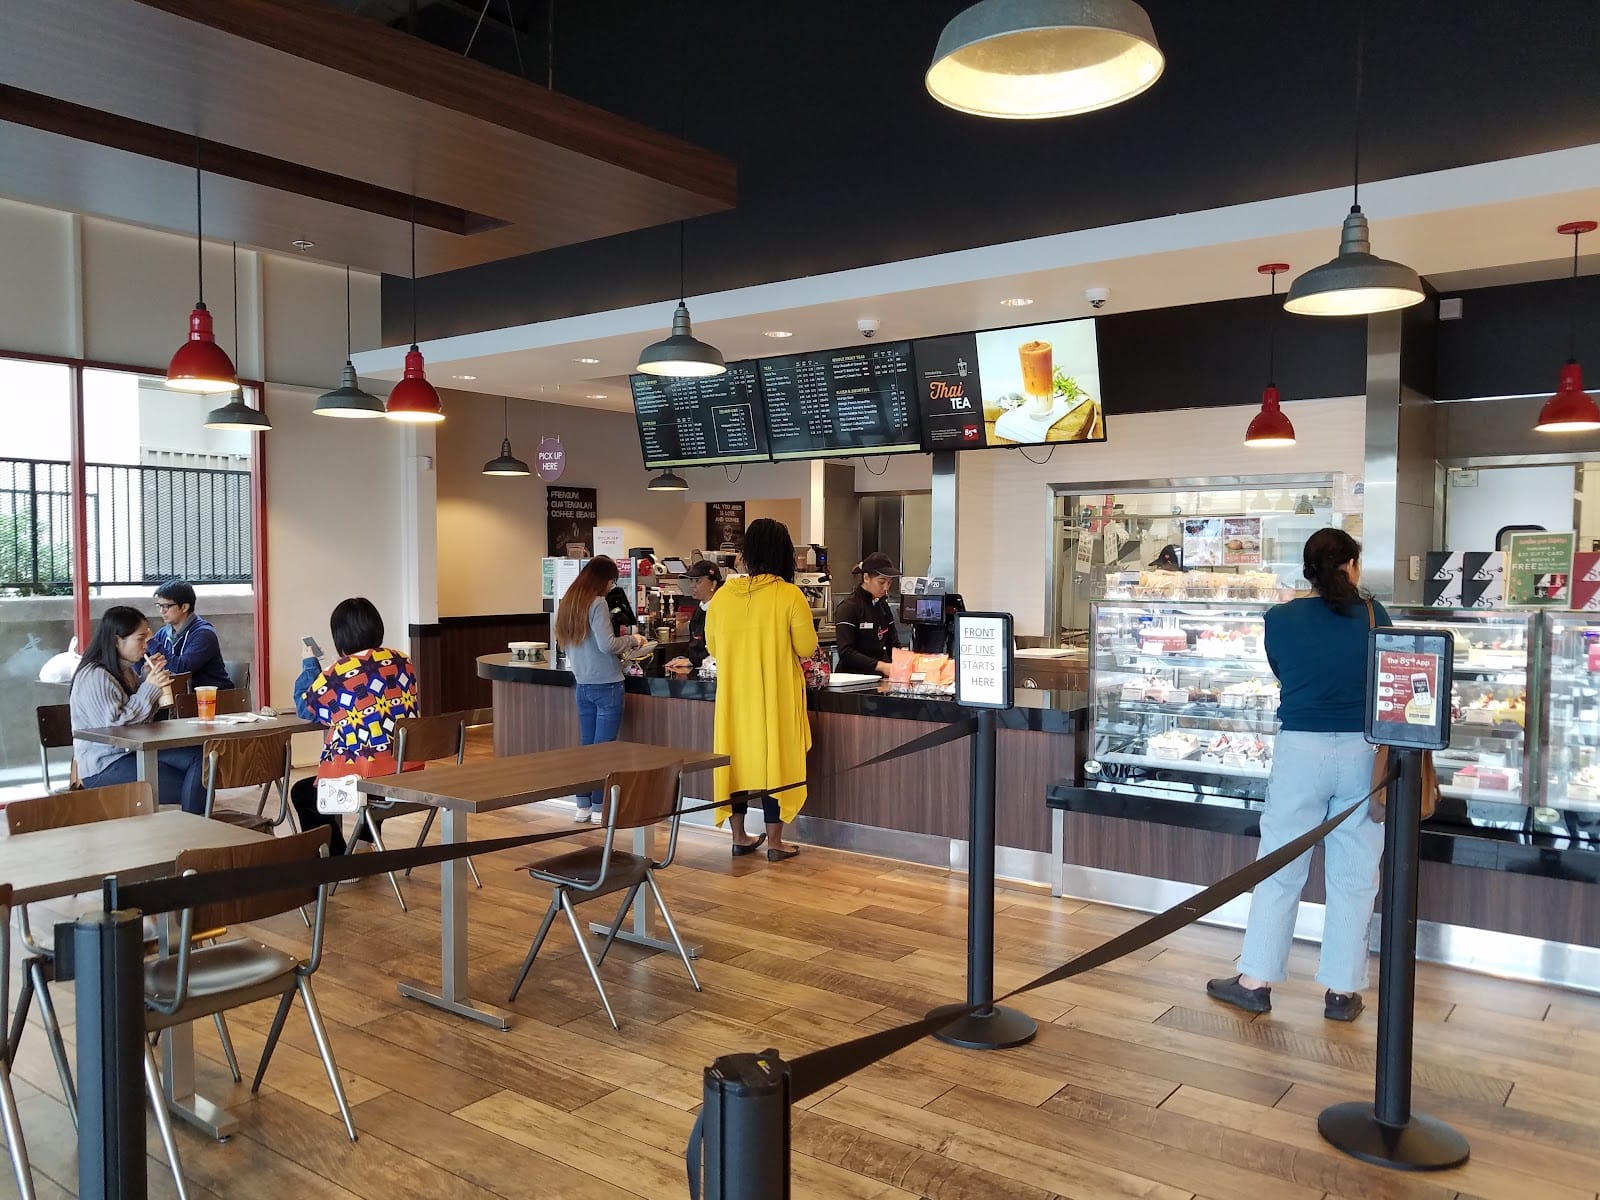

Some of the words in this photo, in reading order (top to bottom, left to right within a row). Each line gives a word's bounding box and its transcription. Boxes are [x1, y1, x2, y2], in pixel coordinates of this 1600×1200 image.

[930, 381, 964, 399] Thai
[950, 397, 971, 410] TEA
[539, 452, 553, 460] PICK
[554, 452, 562, 460] UP
[551, 491, 579, 499] PREMIUM
[551, 510, 575, 518] COFFEE
[964, 627, 995, 637] FRONT
[961, 644, 973, 653] OF
[975, 645, 995, 655] LINE
[962, 661, 995, 671] STARTS
[1416, 659, 1430, 667] App
[971, 677, 995, 687] HERE
